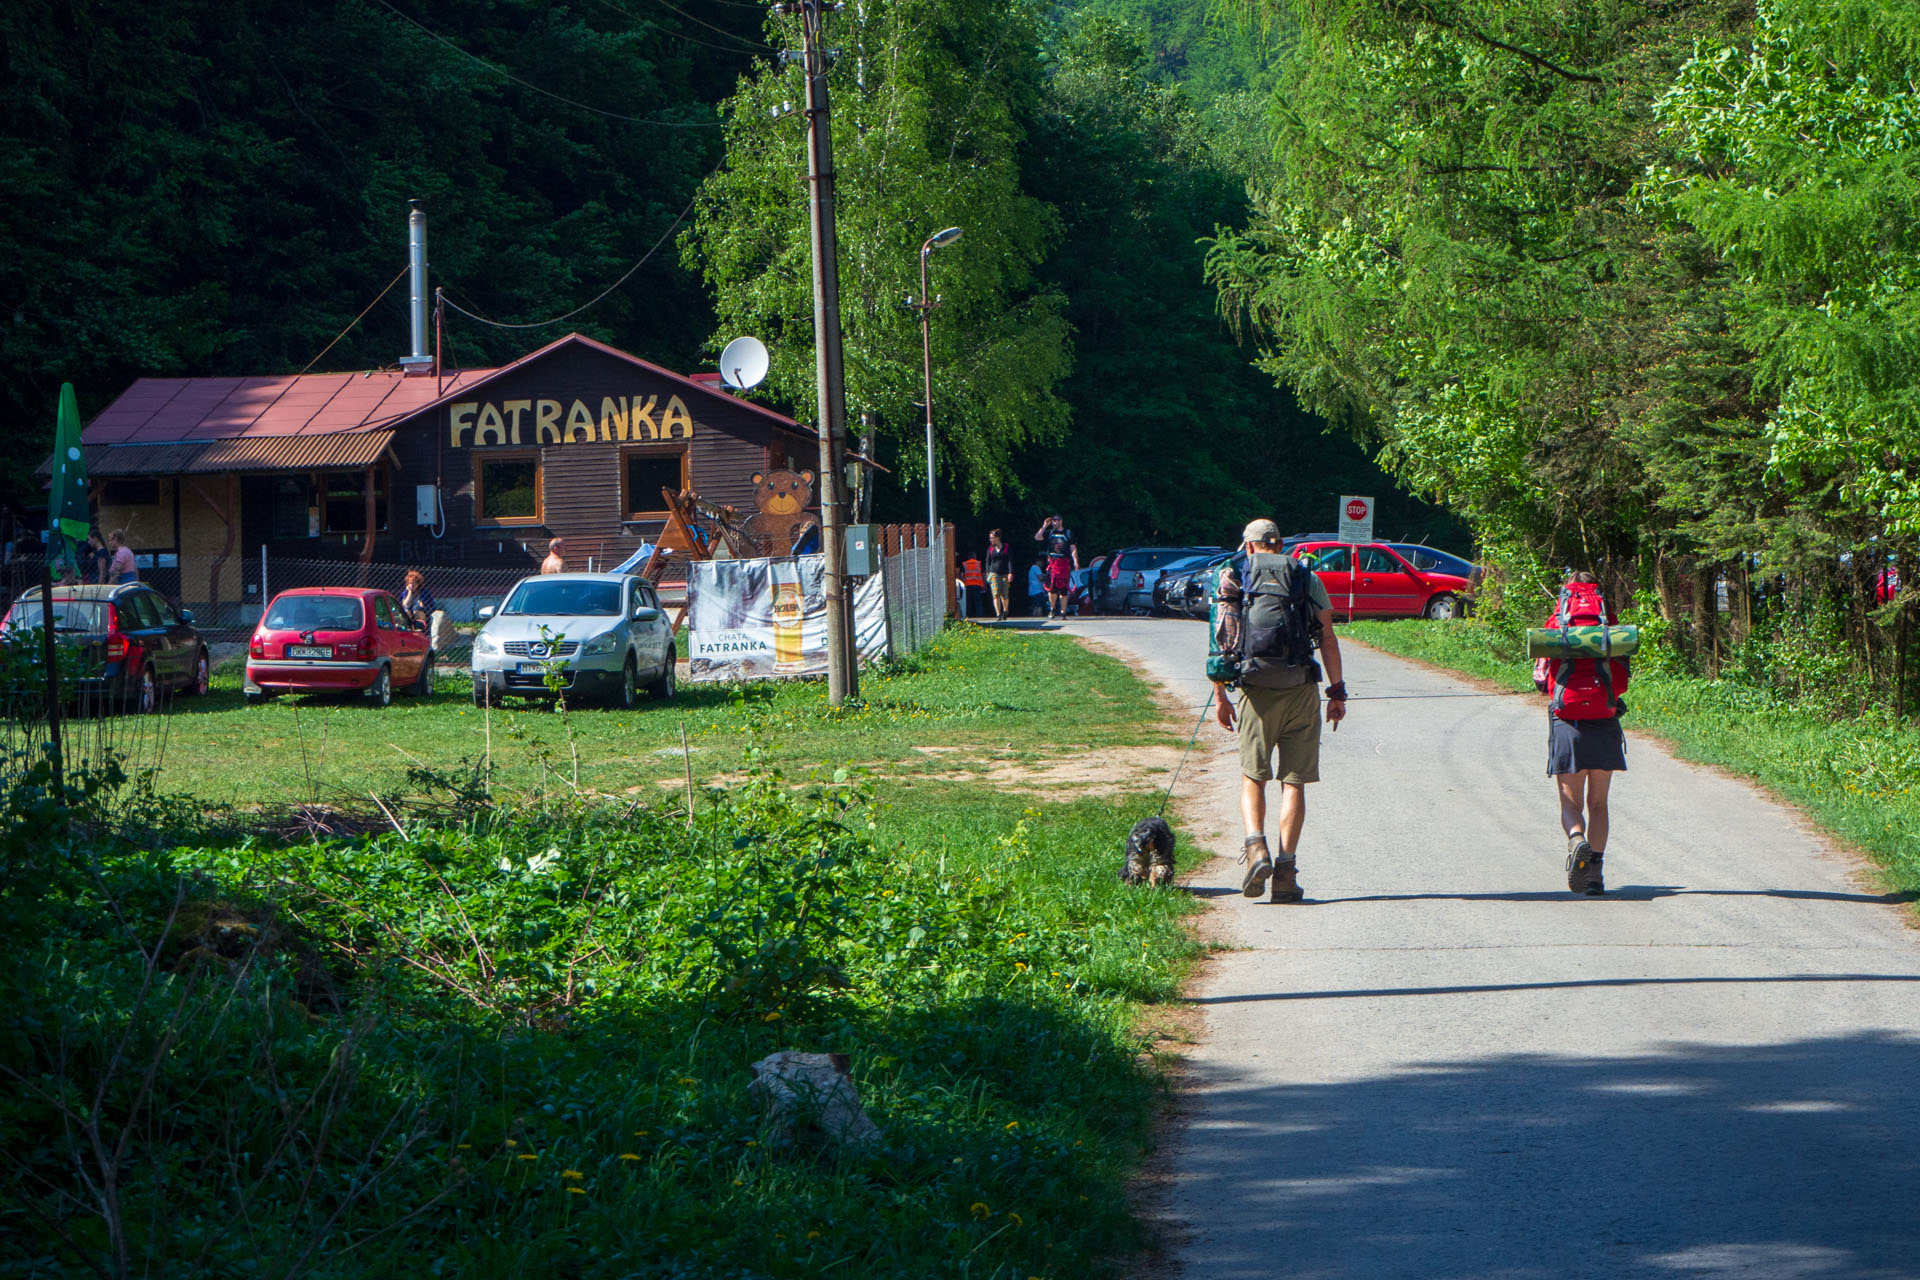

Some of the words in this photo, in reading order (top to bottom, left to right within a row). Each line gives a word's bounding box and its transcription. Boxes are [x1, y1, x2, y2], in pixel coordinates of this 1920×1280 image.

[450, 394, 693, 447] FATRANKA
[1347, 505, 1367, 514] STOP
[718, 633, 747, 641] CHATA
[700, 641, 767, 653] FATRANKA
